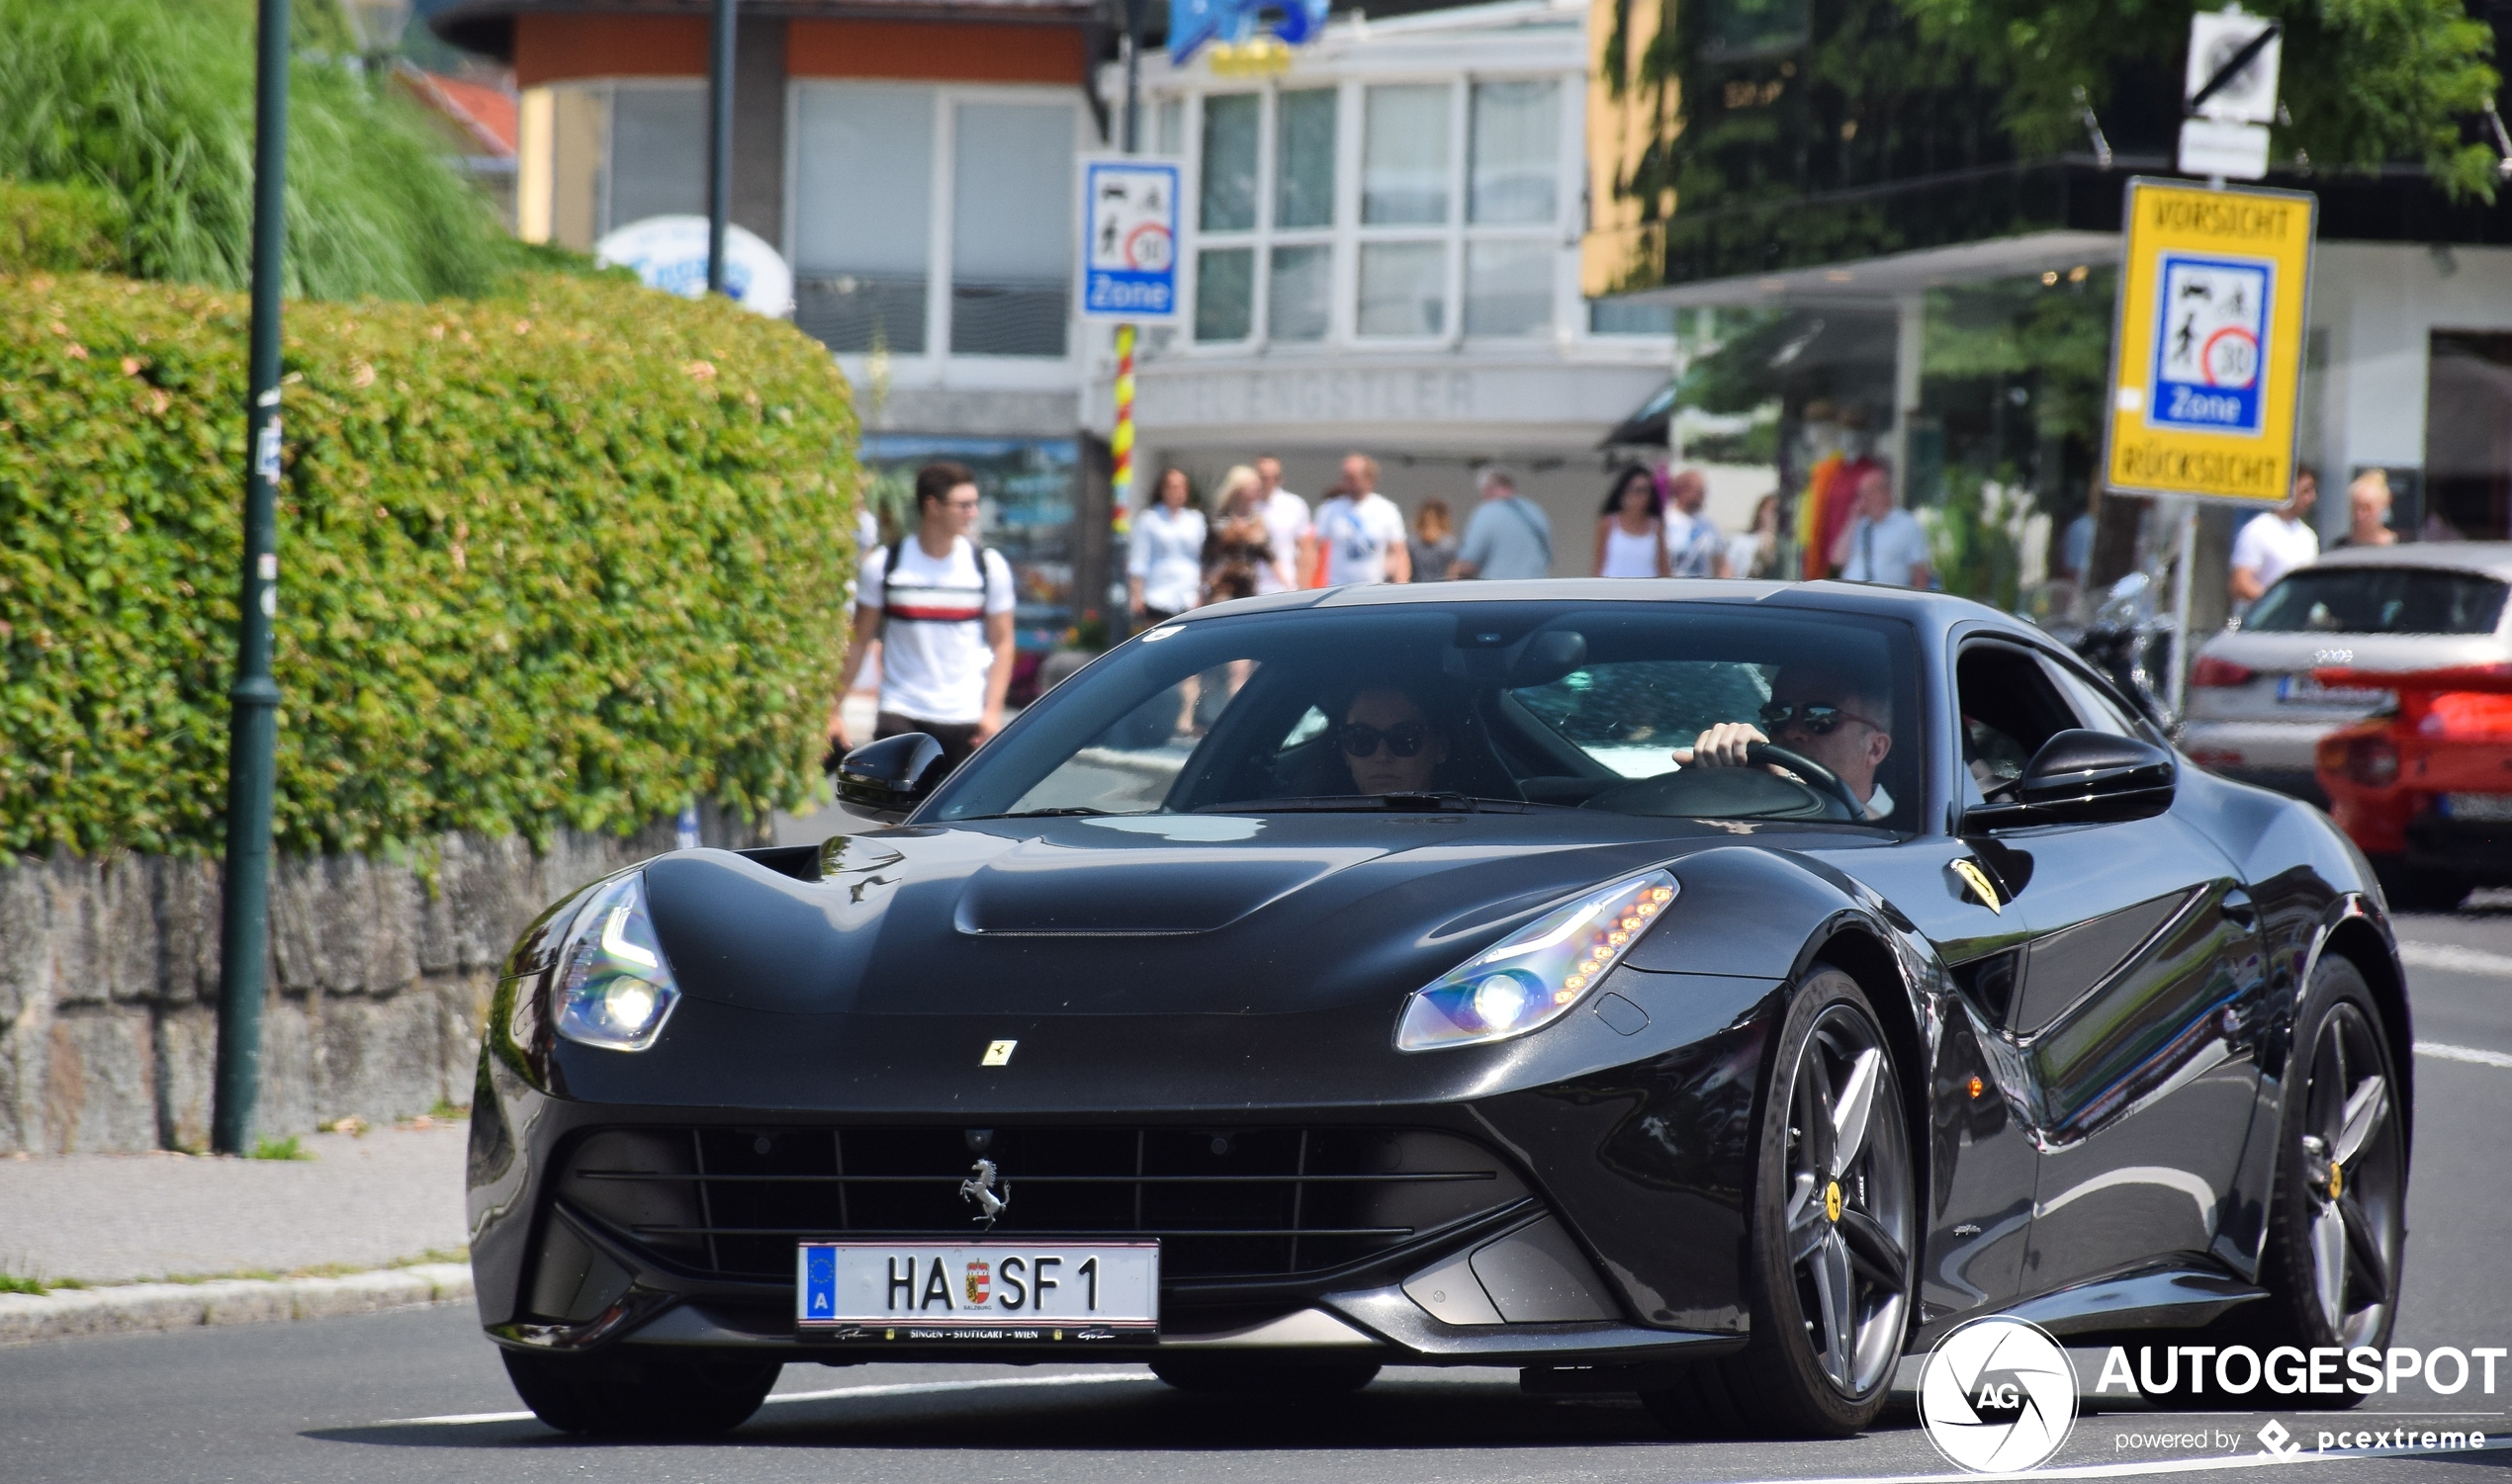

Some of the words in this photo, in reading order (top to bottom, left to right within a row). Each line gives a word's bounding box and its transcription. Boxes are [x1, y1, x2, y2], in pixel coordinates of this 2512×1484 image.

[2154, 198, 2289, 239] VORSICHT
[1091, 273, 1169, 309] Zone
[2220, 341, 2253, 377] 30
[2169, 386, 2241, 424] Zone
[2122, 441, 2277, 490] RÜCKSICHT
[813, 1292, 829, 1310] A
[888, 1256, 955, 1311] HA
[999, 1256, 1063, 1311] SF
[1079, 1256, 1099, 1311] 1
[910, 1329, 943, 1339] SINGEN
[953, 1330, 1003, 1339] STUTTGART
[1014, 1330, 1038, 1339] WIEN
